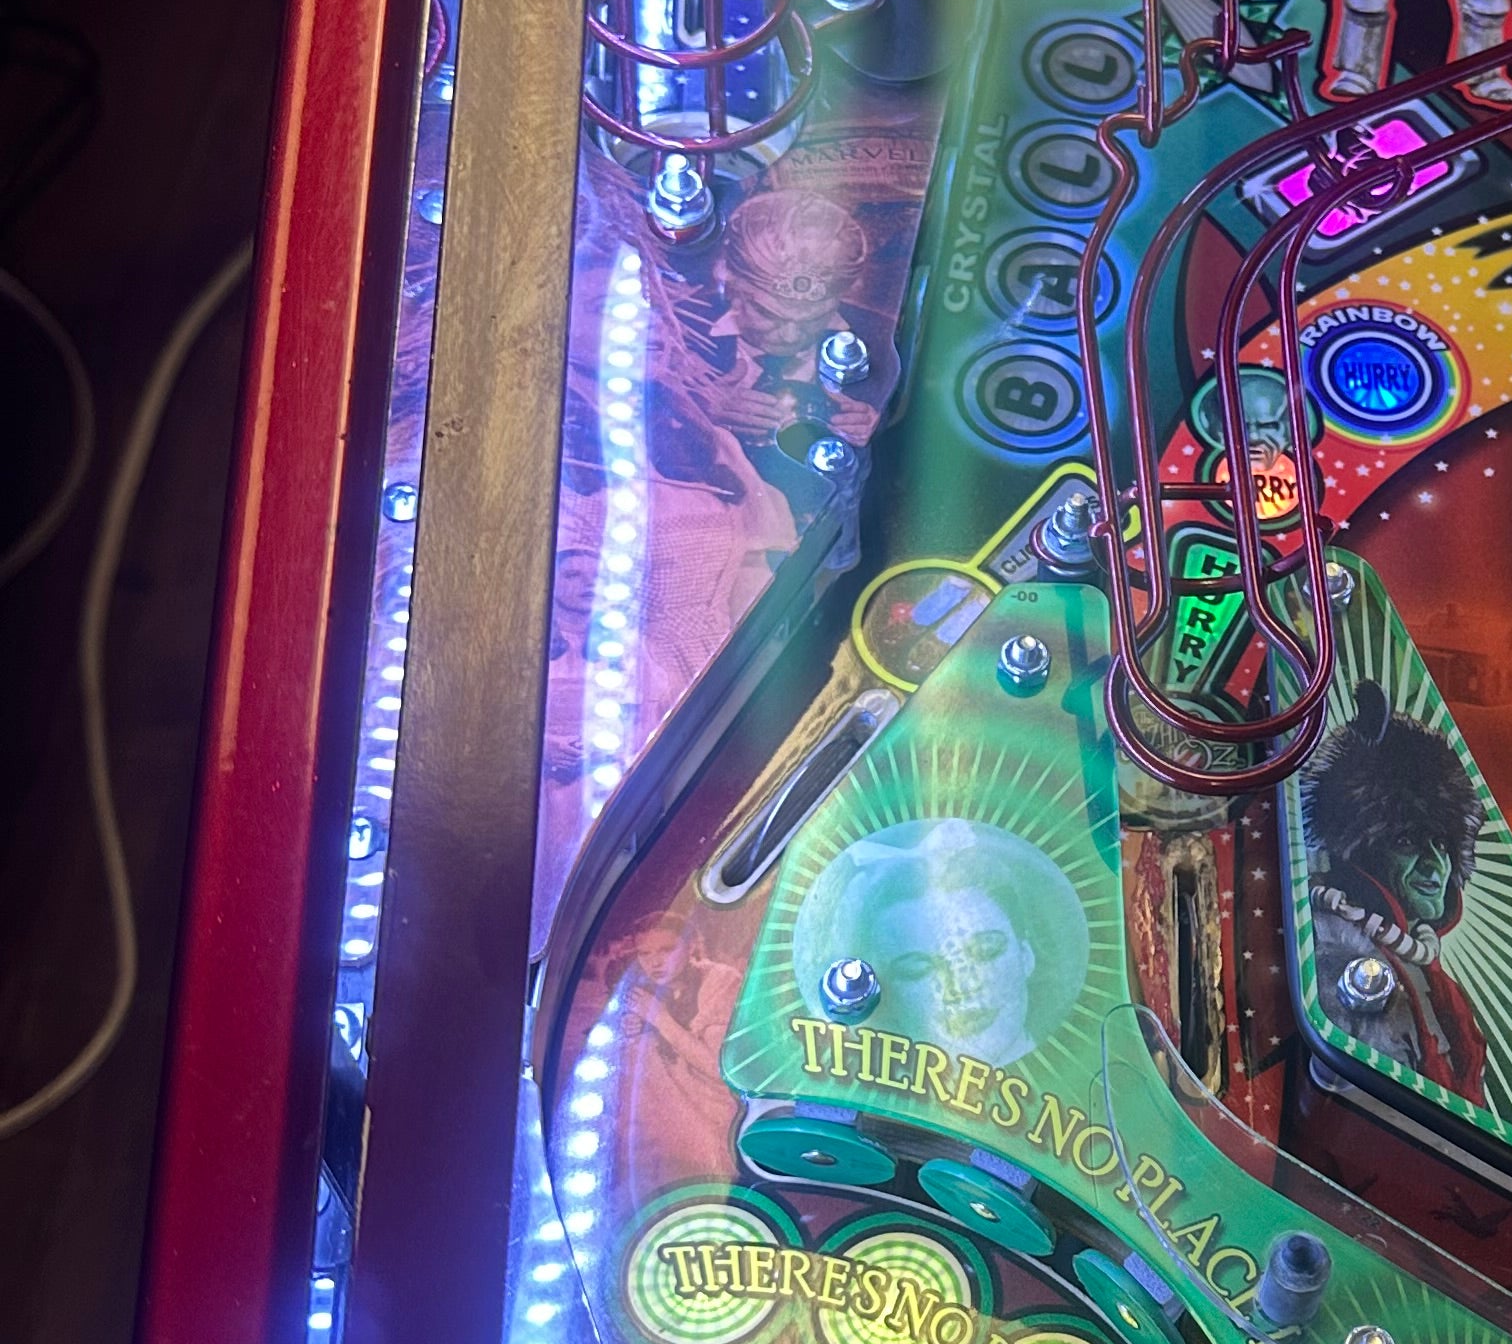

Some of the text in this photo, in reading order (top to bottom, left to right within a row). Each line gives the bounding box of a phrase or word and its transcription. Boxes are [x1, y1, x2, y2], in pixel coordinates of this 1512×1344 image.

[791, 146, 930, 169] MARVEL
[943, 113, 1007, 313] CRYSTAL
[1300, 306, 1447, 352] RAINBOW
[1342, 358, 1412, 394] HURRY
[1173, 553, 1238, 684] HRRY
[791, 1017, 1030, 1128] THERE'S
[1026, 1093, 1121, 1177] NO
[662, 1244, 887, 1317] THERE'S
